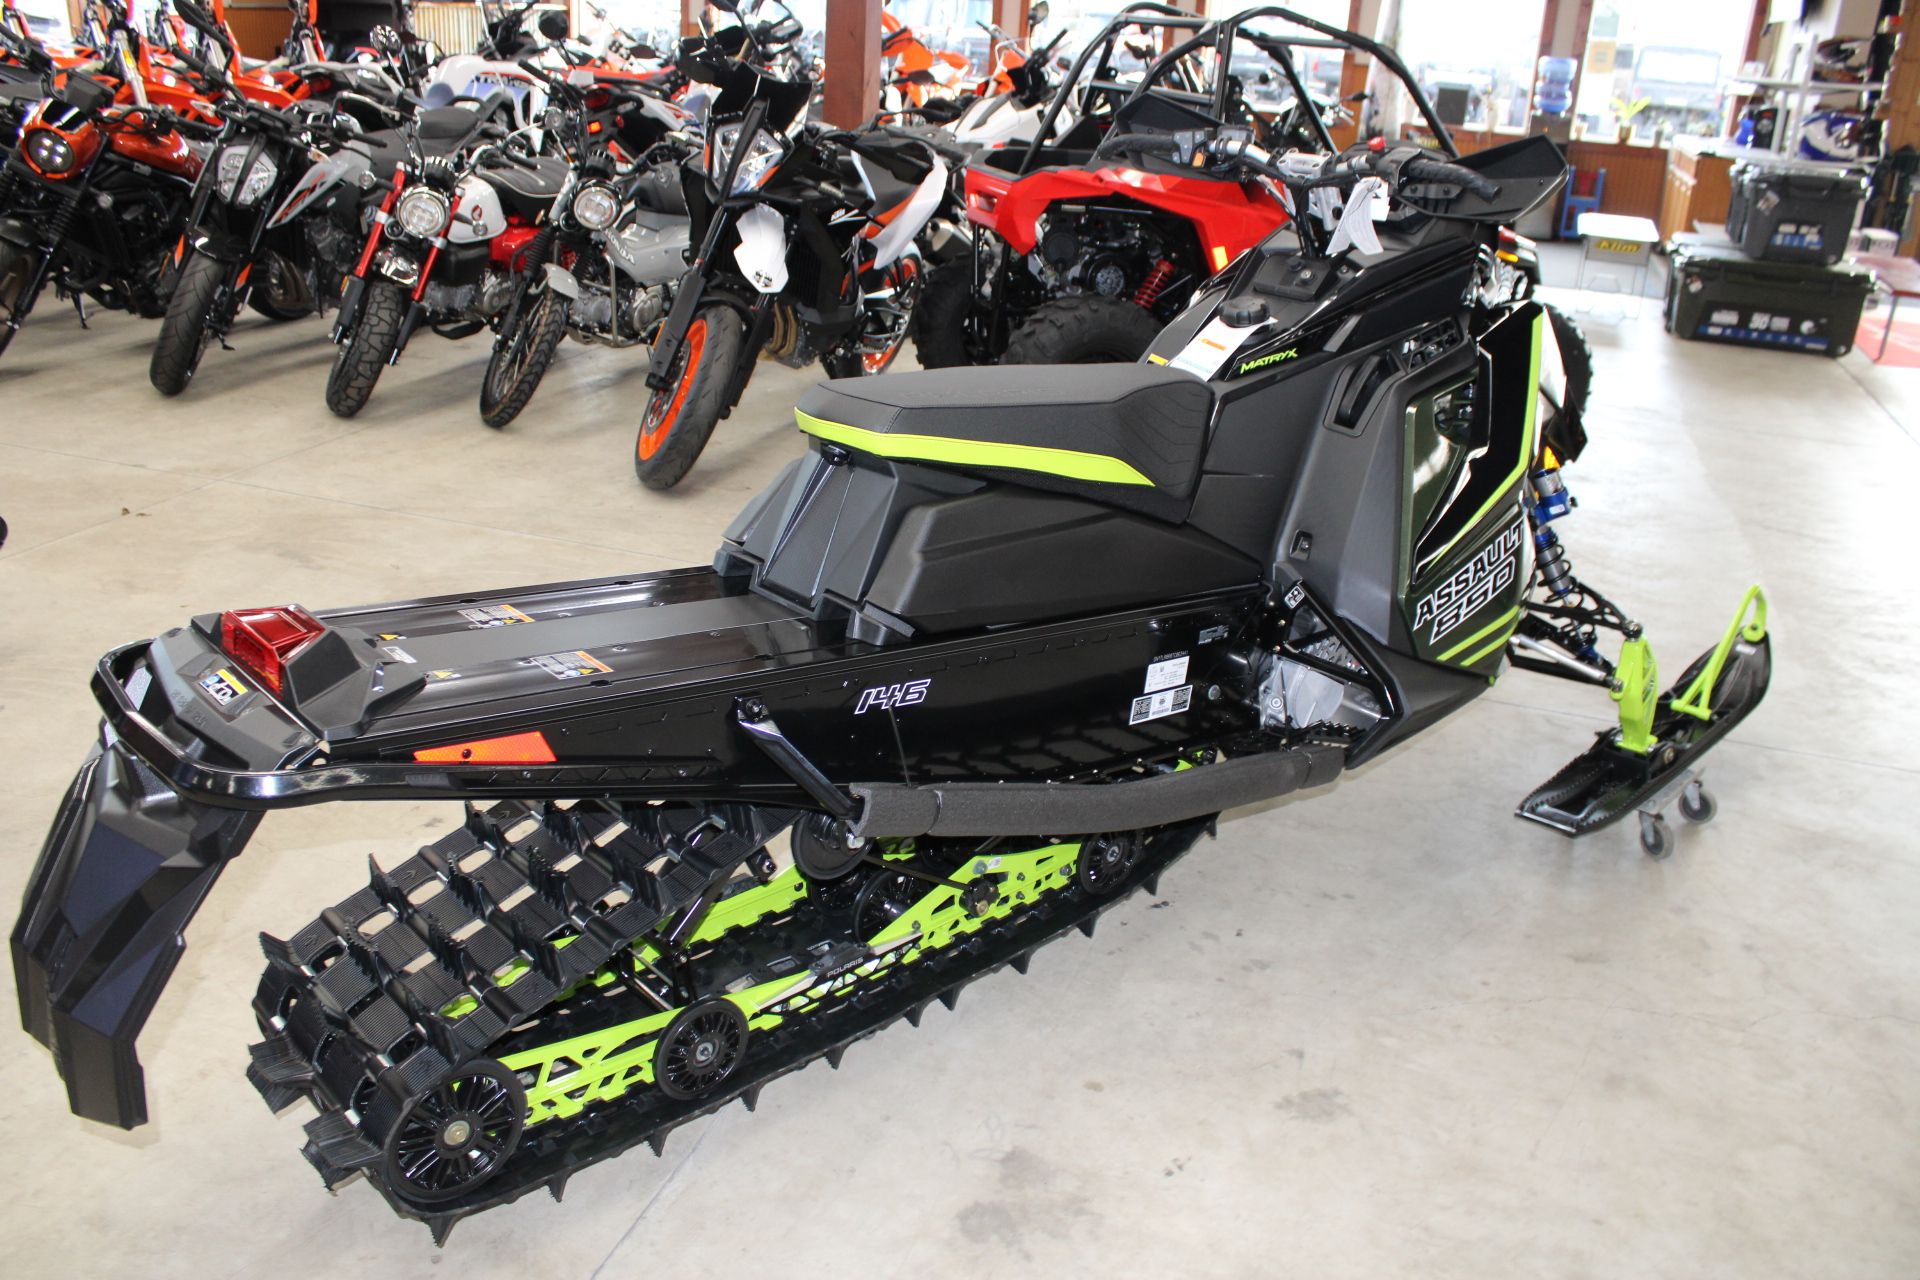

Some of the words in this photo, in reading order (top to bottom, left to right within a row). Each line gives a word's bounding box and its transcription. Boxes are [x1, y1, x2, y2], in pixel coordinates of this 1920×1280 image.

[1239, 347, 1299, 375] MATRYX
[1413, 515, 1525, 632] ASSAULT
[1429, 555, 1516, 646] 850
[854, 678, 931, 715] 146
[827, 956, 864, 978] POLARIS
